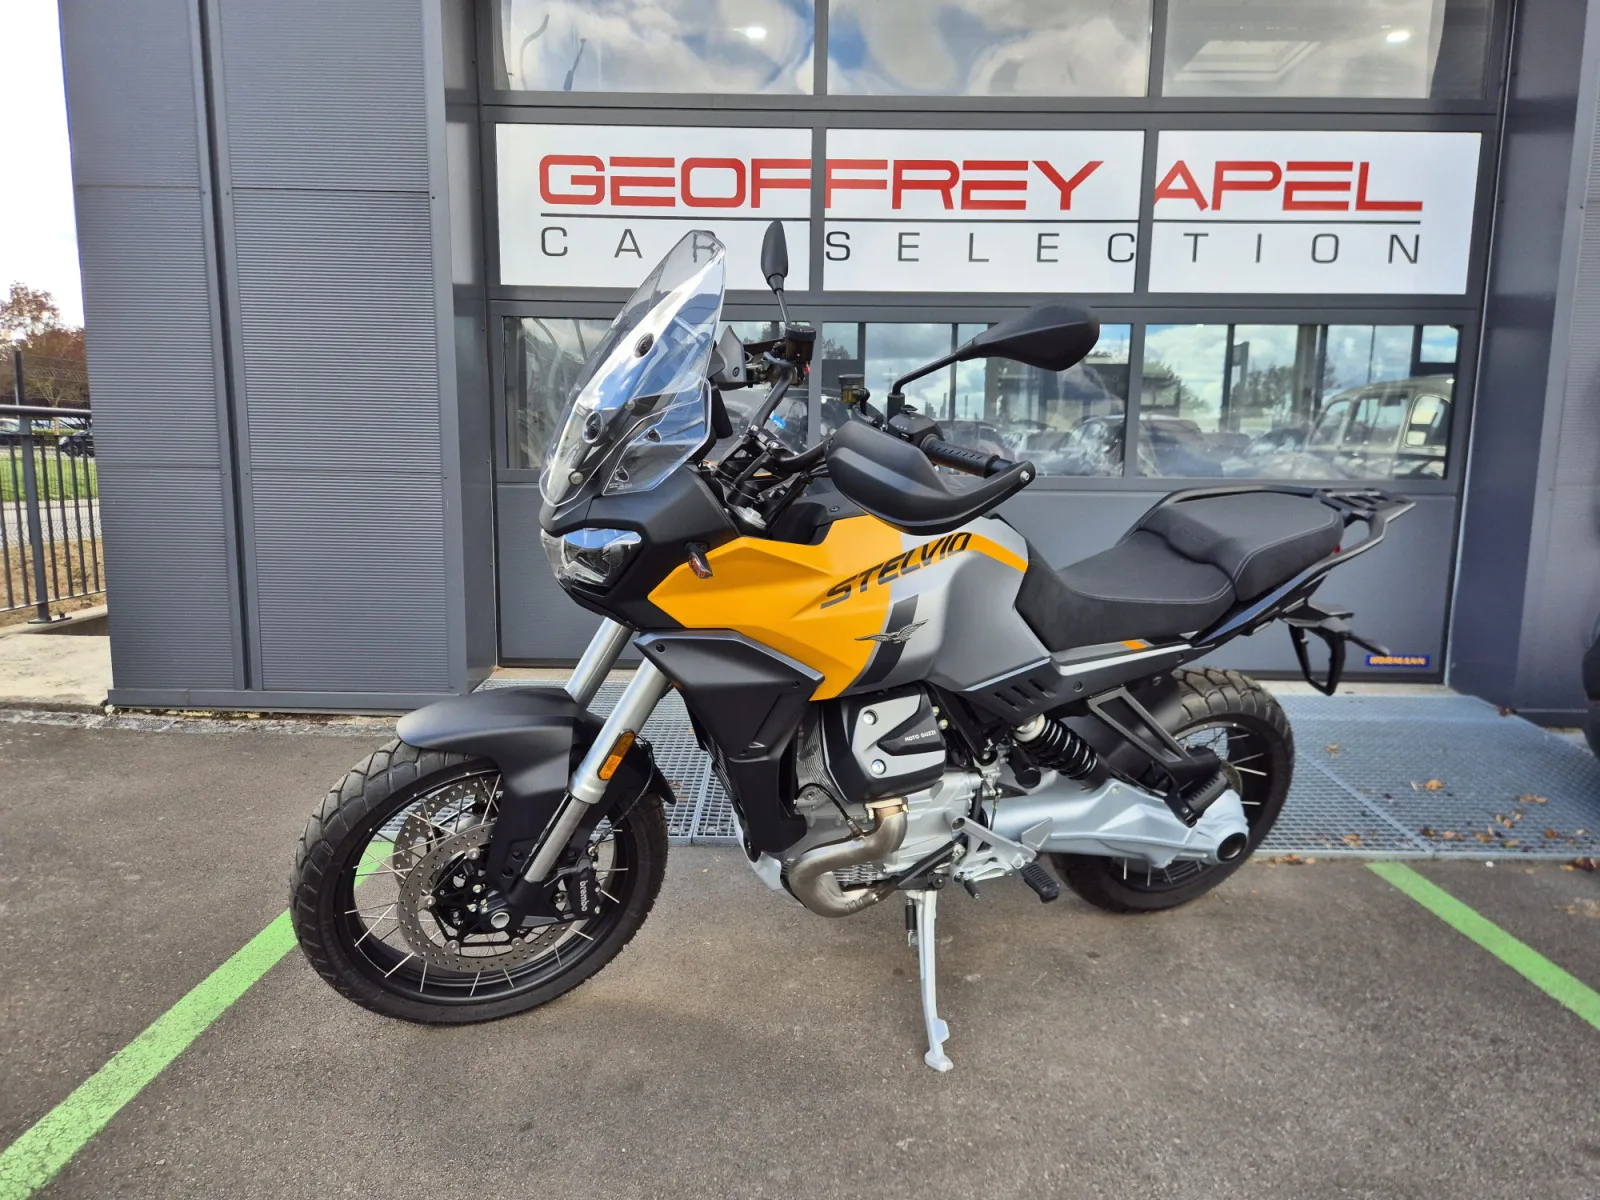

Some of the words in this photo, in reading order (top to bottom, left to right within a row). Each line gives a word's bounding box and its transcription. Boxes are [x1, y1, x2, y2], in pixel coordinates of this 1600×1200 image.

[539, 154, 1104, 210] GEOFFREY
[1154, 160, 1423, 211] APEL
[541, 226, 720, 263] CAR
[825, 231, 1420, 264] SELECTION
[820, 532, 972, 609] STELVIO
[904, 734, 920, 742] MOTO
[920, 729, 936, 738] GUZZI
[579, 879, 590, 911] brembo
